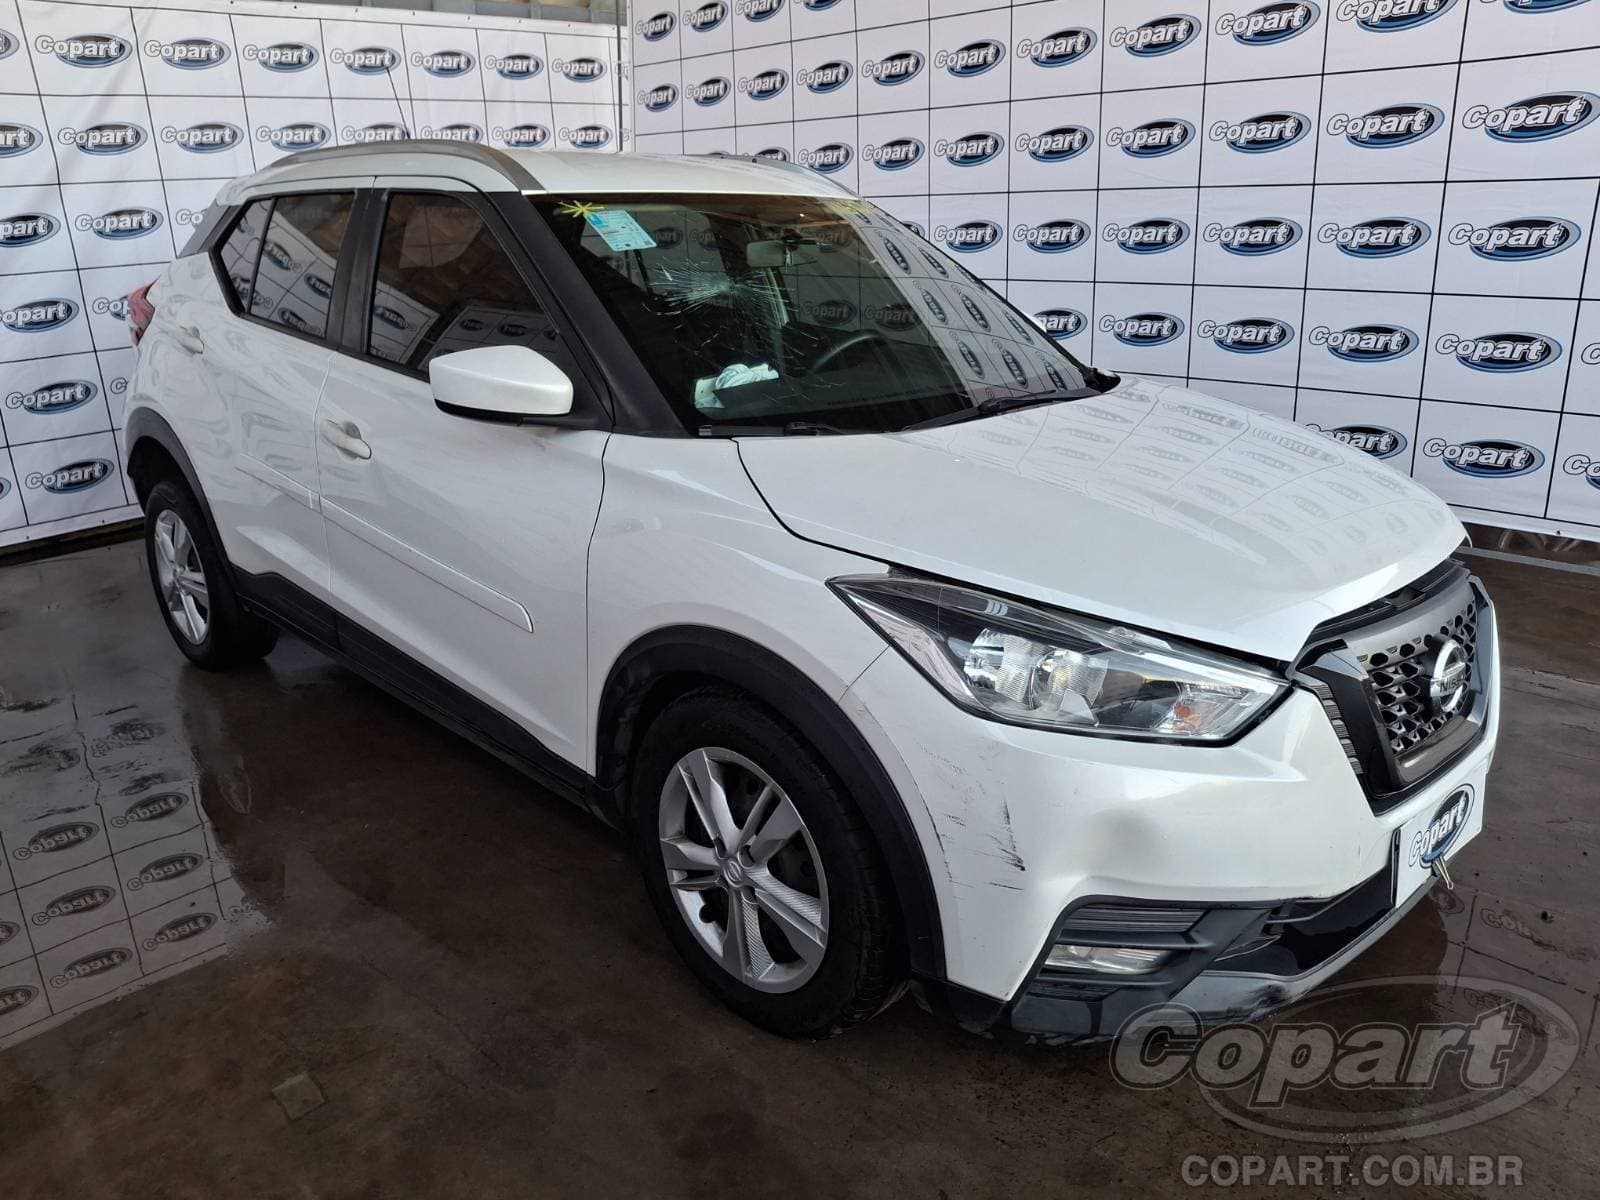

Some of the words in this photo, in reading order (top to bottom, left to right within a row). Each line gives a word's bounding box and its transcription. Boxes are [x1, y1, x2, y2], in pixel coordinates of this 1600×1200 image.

[636, 16, 671, 34] Copart
[684, 6, 724, 25] Copart
[1215, 6, 1307, 38] Copart
[1110, 18, 1191, 48] Copart
[35, 35, 121, 58] Copart
[145, 39, 220, 61] Copart
[243, 45, 311, 64] Copart
[1017, 32, 1088, 58] Copart
[330, 49, 392, 66] Copart
[411, 52, 468, 68] Copart
[485, 56, 536, 71] Copart
[552, 60, 600, 73] Copart
[862, 54, 917, 76] Copart
[935, 45, 997, 69] Copart
[739, 75, 784, 93] Copart
[797, 66, 847, 84] Copart
[638, 90, 672, 106] Copart
[686, 81, 726, 98] Copart
[1327, 108, 1431, 139] Copart
[1462, 96, 1586, 133] Copart
[58, 127, 137, 147] Copart
[161, 127, 234, 146] Copart
[256, 126, 323, 144] Copart
[492, 128, 542, 142] Copart
[559, 129, 607, 143] Copart
[1106, 124, 1184, 150] Copart
[1209, 116, 1298, 144] Copart
[863, 142, 916, 163] Copart
[935, 136, 996, 160] Copart
[1015, 131, 1083, 153] Copart
[798, 147, 847, 167] Copart
[0, 216, 48, 240] part
[76, 212, 151, 234] Copart
[1013, 224, 1083, 244] Copart
[1102, 223, 1181, 245] Copart
[934, 226, 996, 244] Copart
[1203, 222, 1291, 248] Copart
[1318, 223, 1419, 248] Copart
[1448, 223, 1562, 251] Copart
[0, 302, 67, 328] opart
[802, 304, 850, 323] Copart
[1099, 315, 1173, 337] Copart
[1198, 320, 1283, 345] Copart
[1309, 326, 1406, 353] Copart
[1435, 334, 1547, 362] Copart
[6, 383, 86, 409] Copart
[1423, 438, 1530, 469] Copart
[26, 463, 104, 488] Copart
[1408, 787, 1467, 867] Copart
